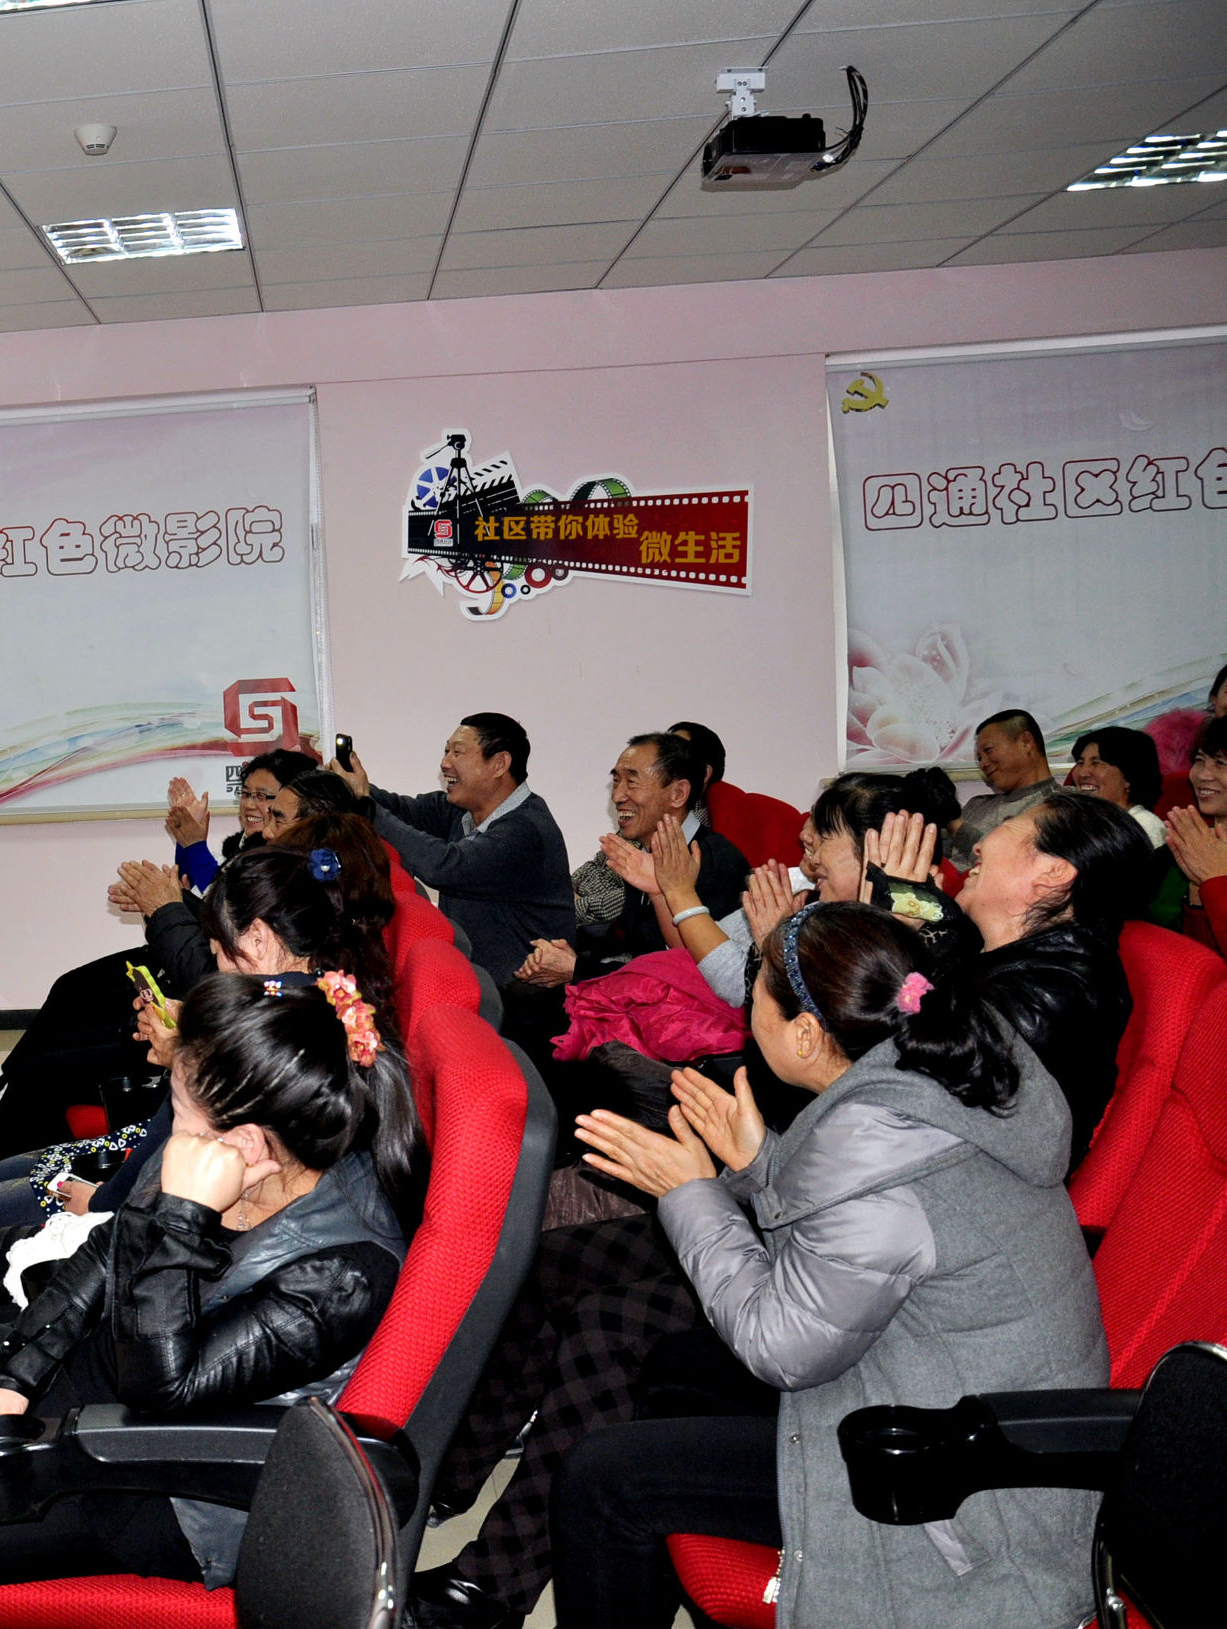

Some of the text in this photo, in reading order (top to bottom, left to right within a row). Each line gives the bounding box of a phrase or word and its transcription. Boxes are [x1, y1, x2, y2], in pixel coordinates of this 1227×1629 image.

[474, 514, 639, 541] 社区带你体验
[639, 531, 741, 564] 微生活
